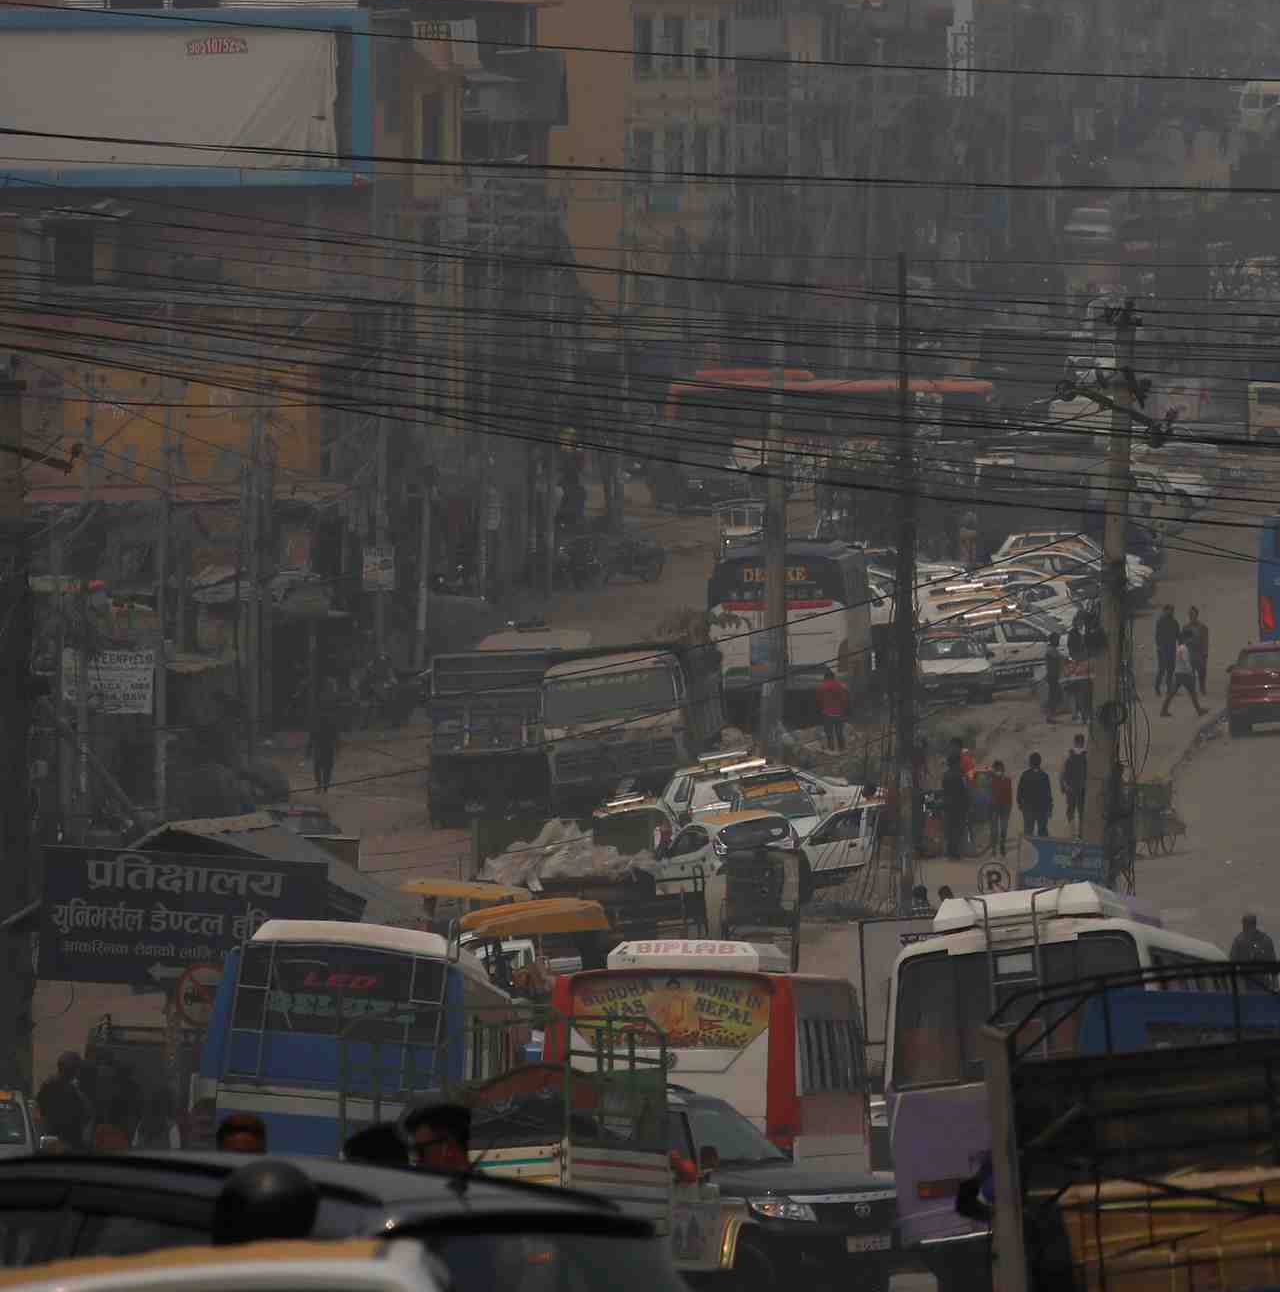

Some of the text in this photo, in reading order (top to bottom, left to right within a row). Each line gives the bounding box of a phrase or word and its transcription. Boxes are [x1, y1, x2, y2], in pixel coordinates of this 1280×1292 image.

[638, 942, 738, 955] BIPLAB
[581, 979, 655, 1006] BUDDHA
[694, 979, 738, 1003] BORN
[601, 999, 647, 1015] WAS
[694, 996, 753, 1023] NEPAL
